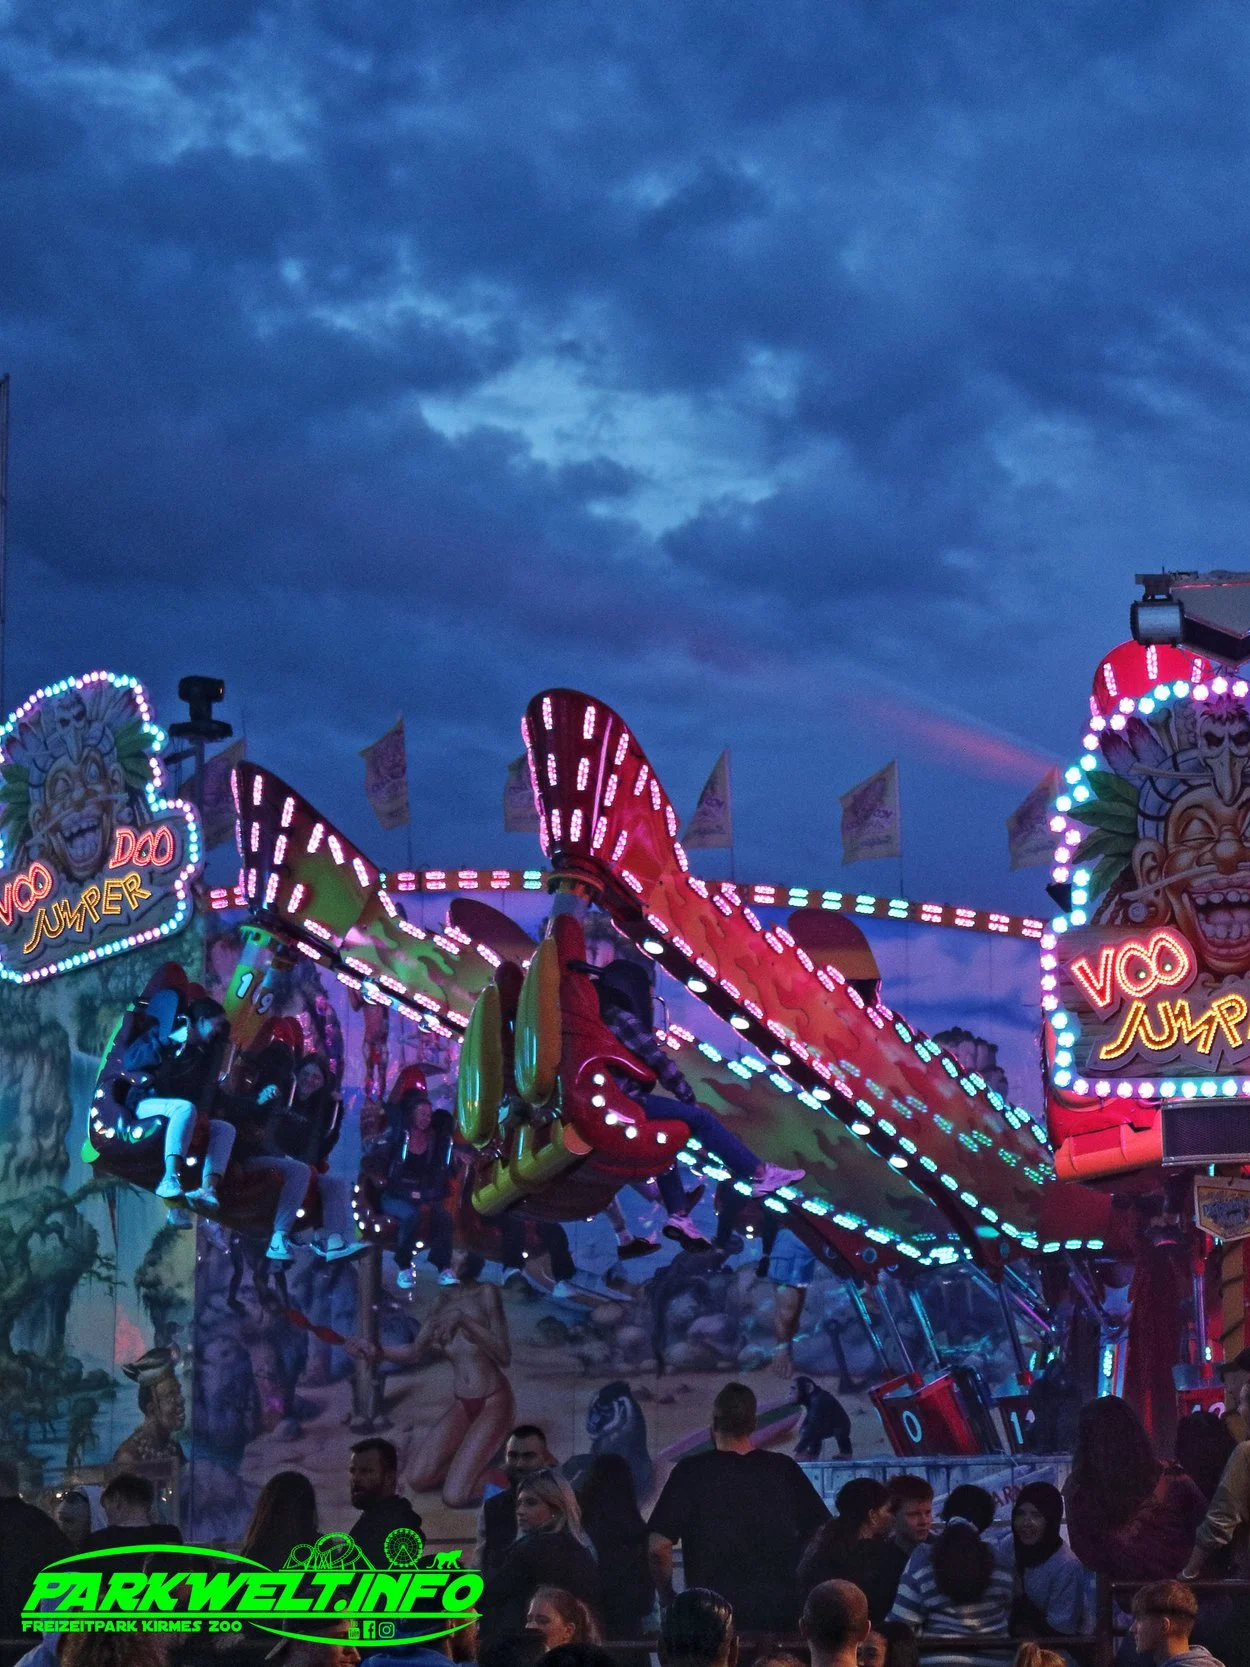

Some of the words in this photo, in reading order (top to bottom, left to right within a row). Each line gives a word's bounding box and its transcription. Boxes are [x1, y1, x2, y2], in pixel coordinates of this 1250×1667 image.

[109, 825, 174, 869] DOO
[23, 871, 151, 954] JUMPER
[1071, 932, 1190, 1008] VOO
